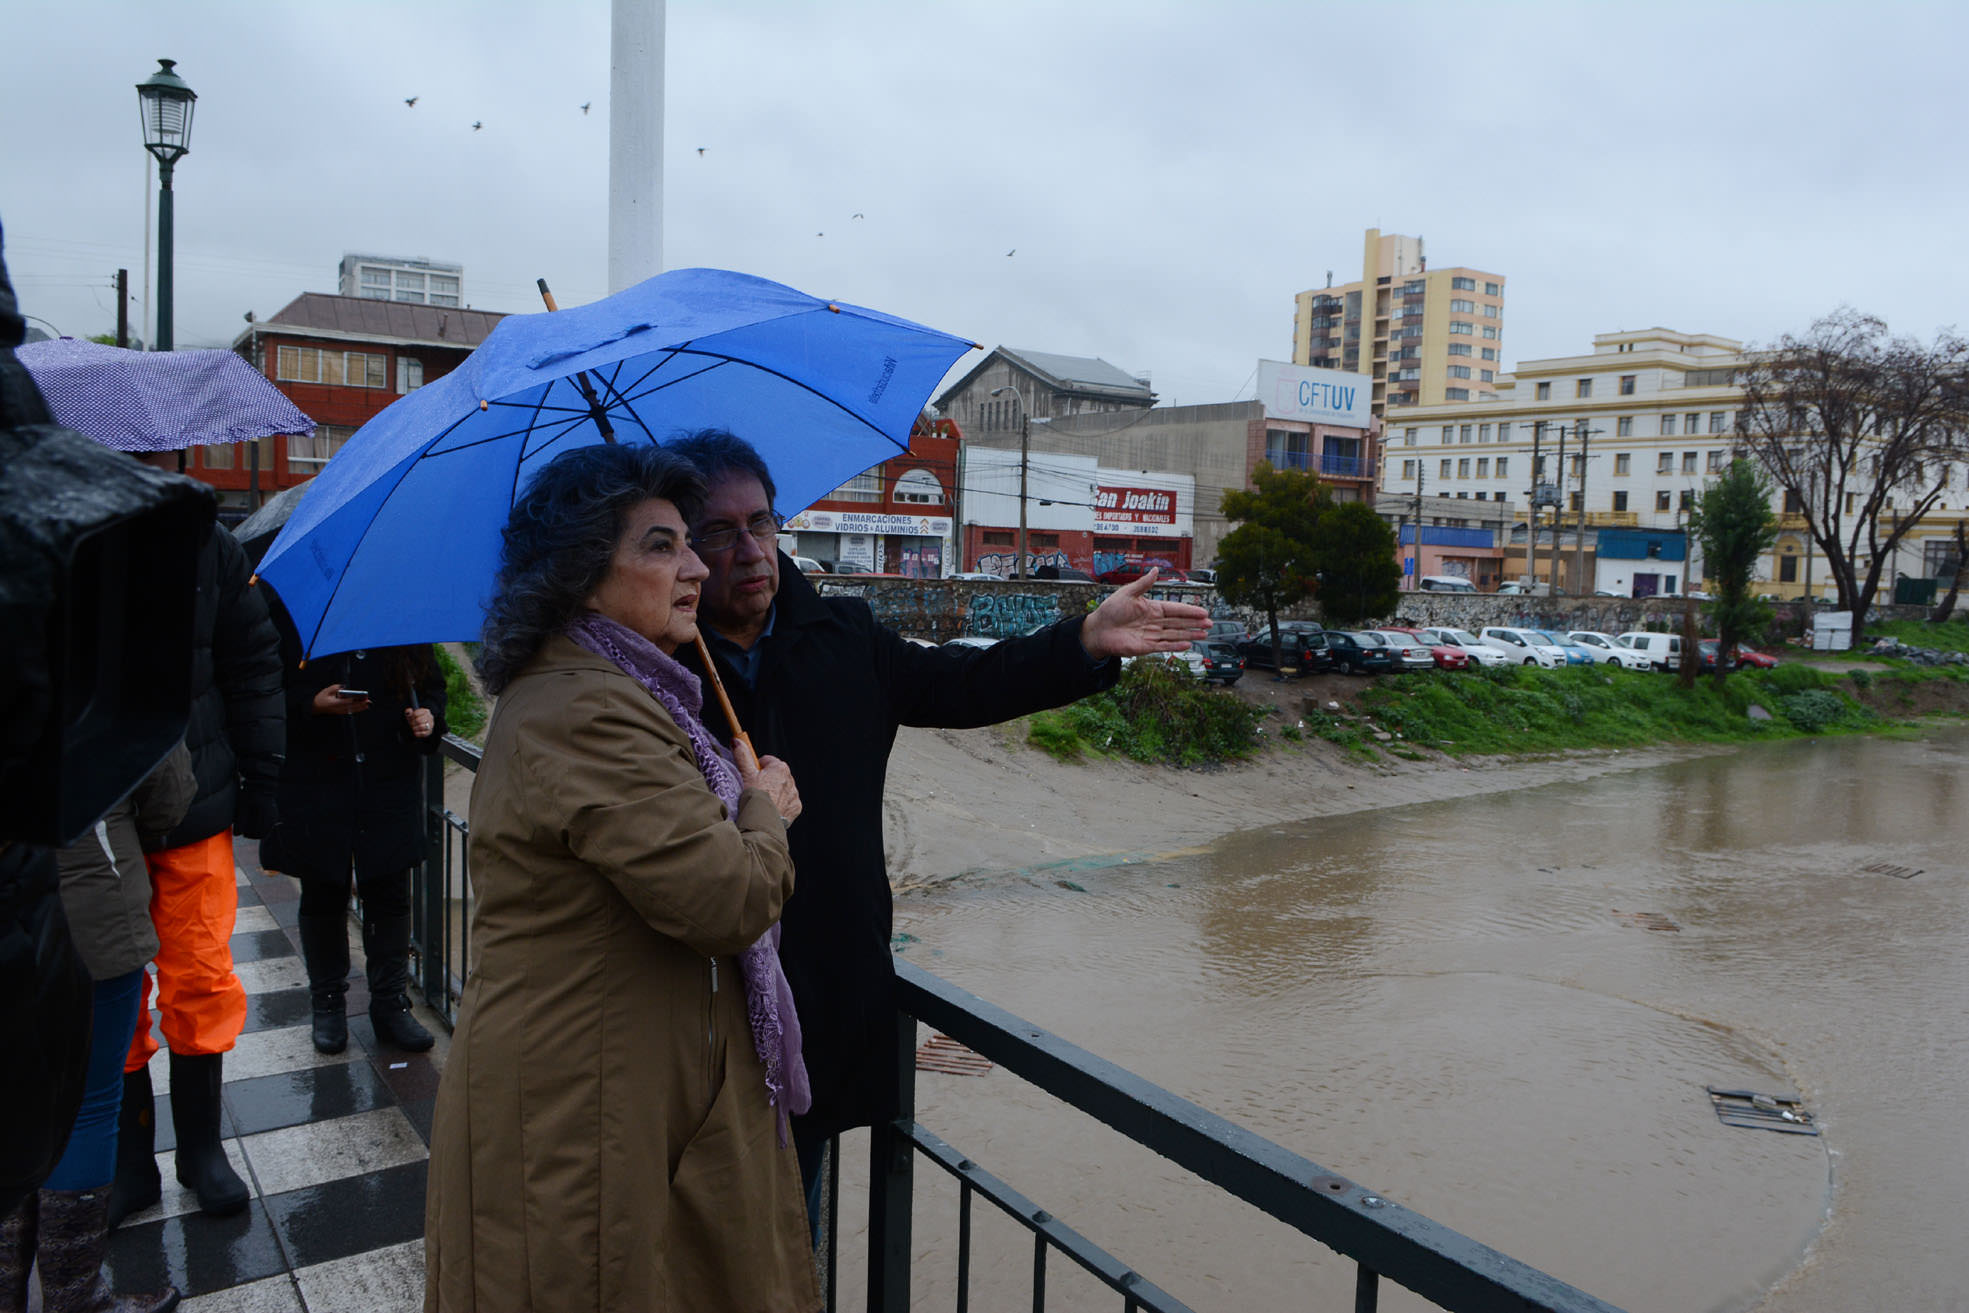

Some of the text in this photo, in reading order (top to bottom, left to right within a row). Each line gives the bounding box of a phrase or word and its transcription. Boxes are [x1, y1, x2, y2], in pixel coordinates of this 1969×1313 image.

[1299, 380, 1355, 411] CFTUV
[842, 513, 912, 524] ENMARCACIONES
[835, 522, 868, 532] VIDRIOS
[875, 524, 918, 534] ALUMINIOS
